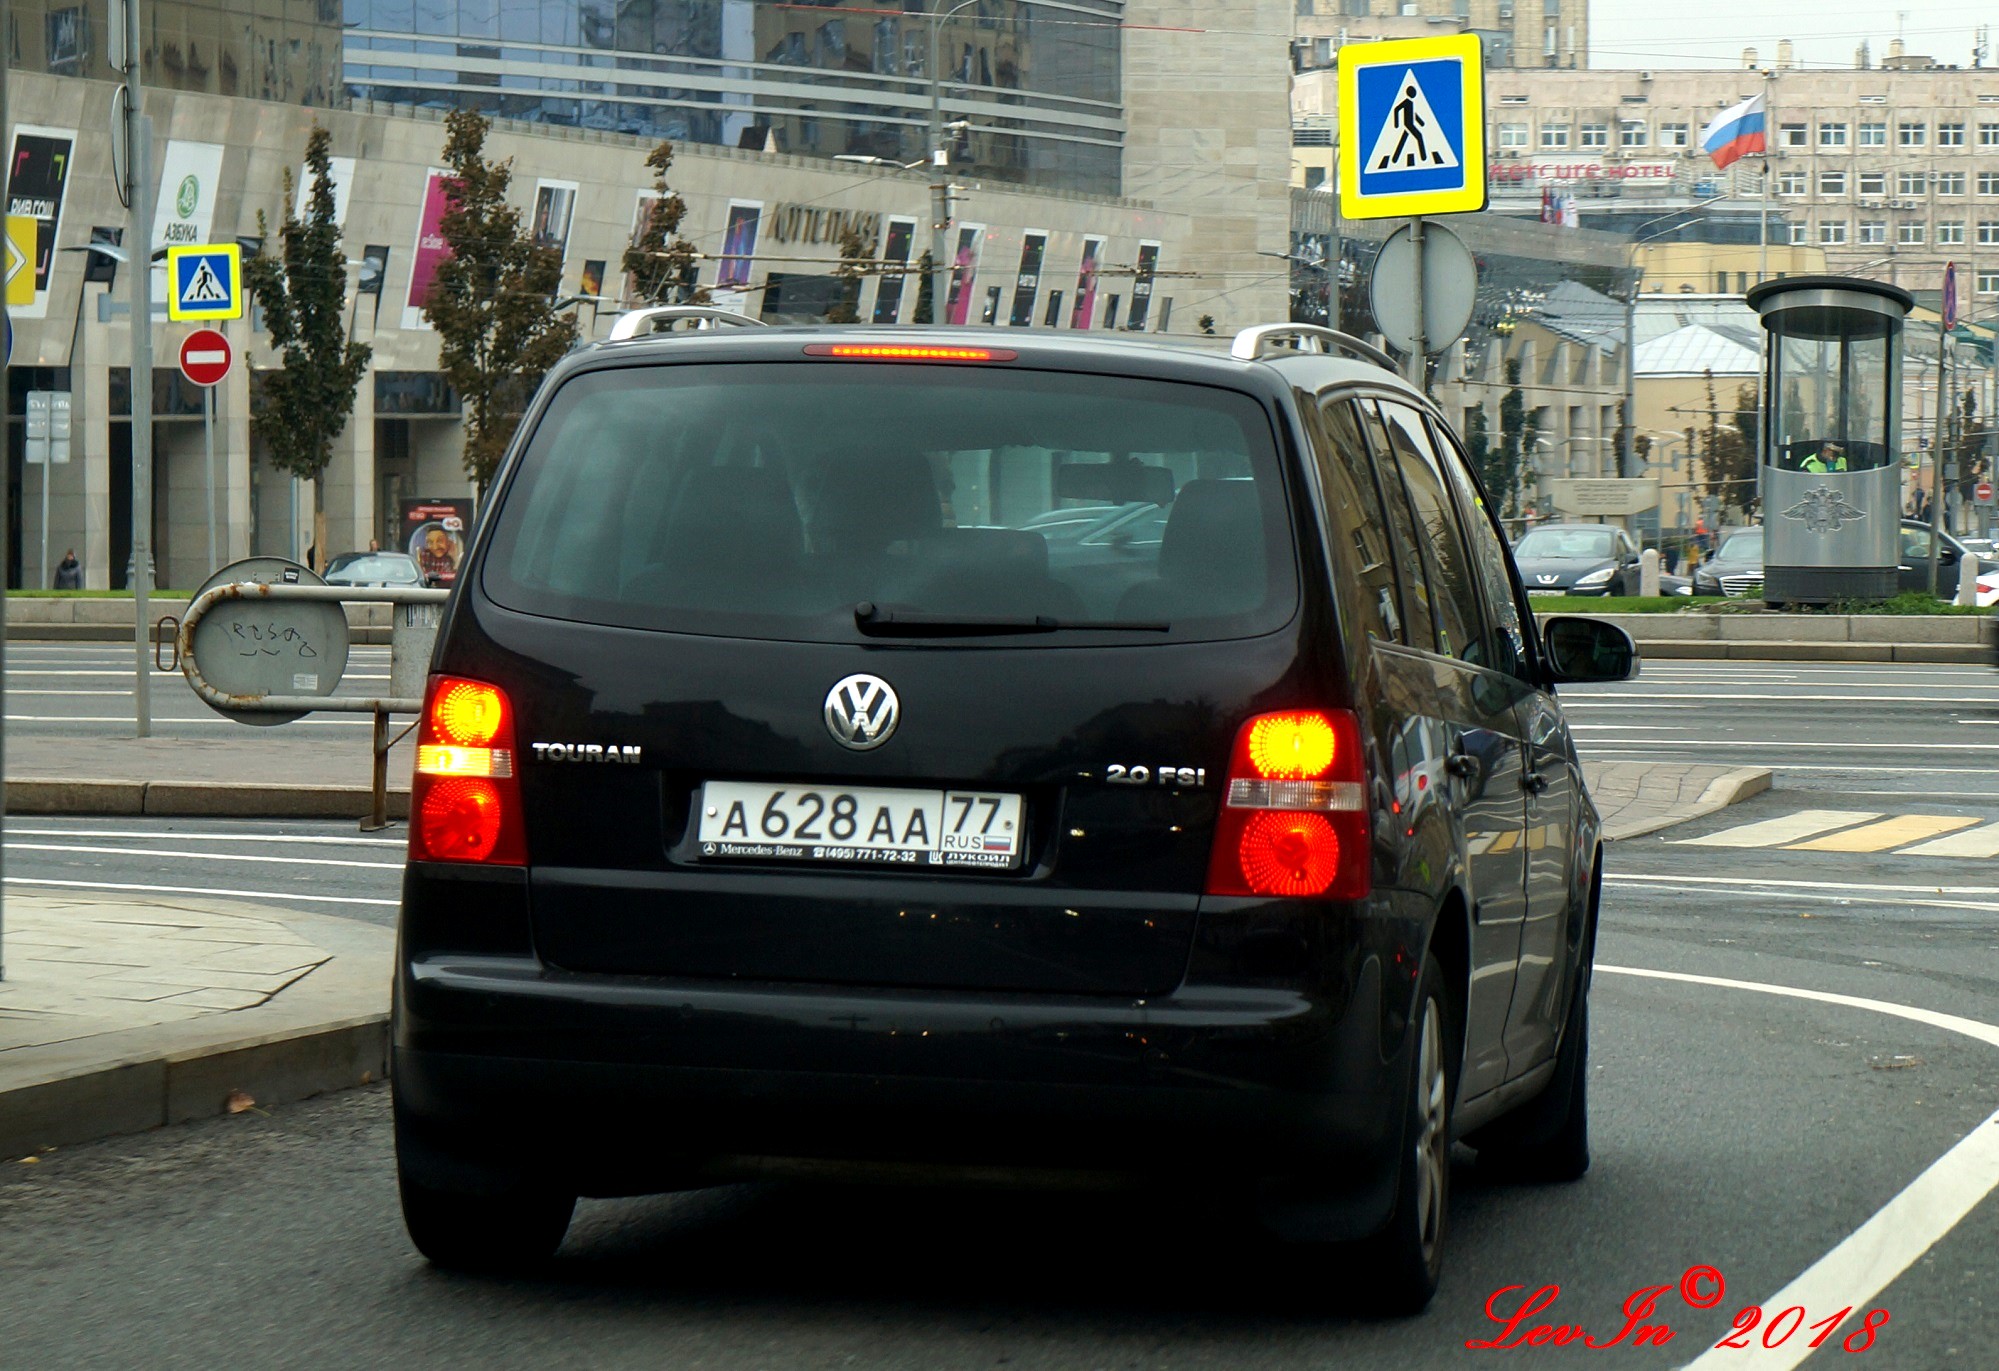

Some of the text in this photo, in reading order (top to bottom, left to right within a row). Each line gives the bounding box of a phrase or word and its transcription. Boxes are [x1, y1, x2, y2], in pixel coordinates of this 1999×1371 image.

[1608, 165, 1676, 178] HOTEL
[164, 223, 198, 242] АЗБУКА
[532, 743, 641, 763] TOURAN
[1158, 766, 1205, 786] FSI
[951, 797, 1002, 834] 77
[720, 844, 803, 857] Mercedes-Benz
[945, 835, 982, 850] RUS
